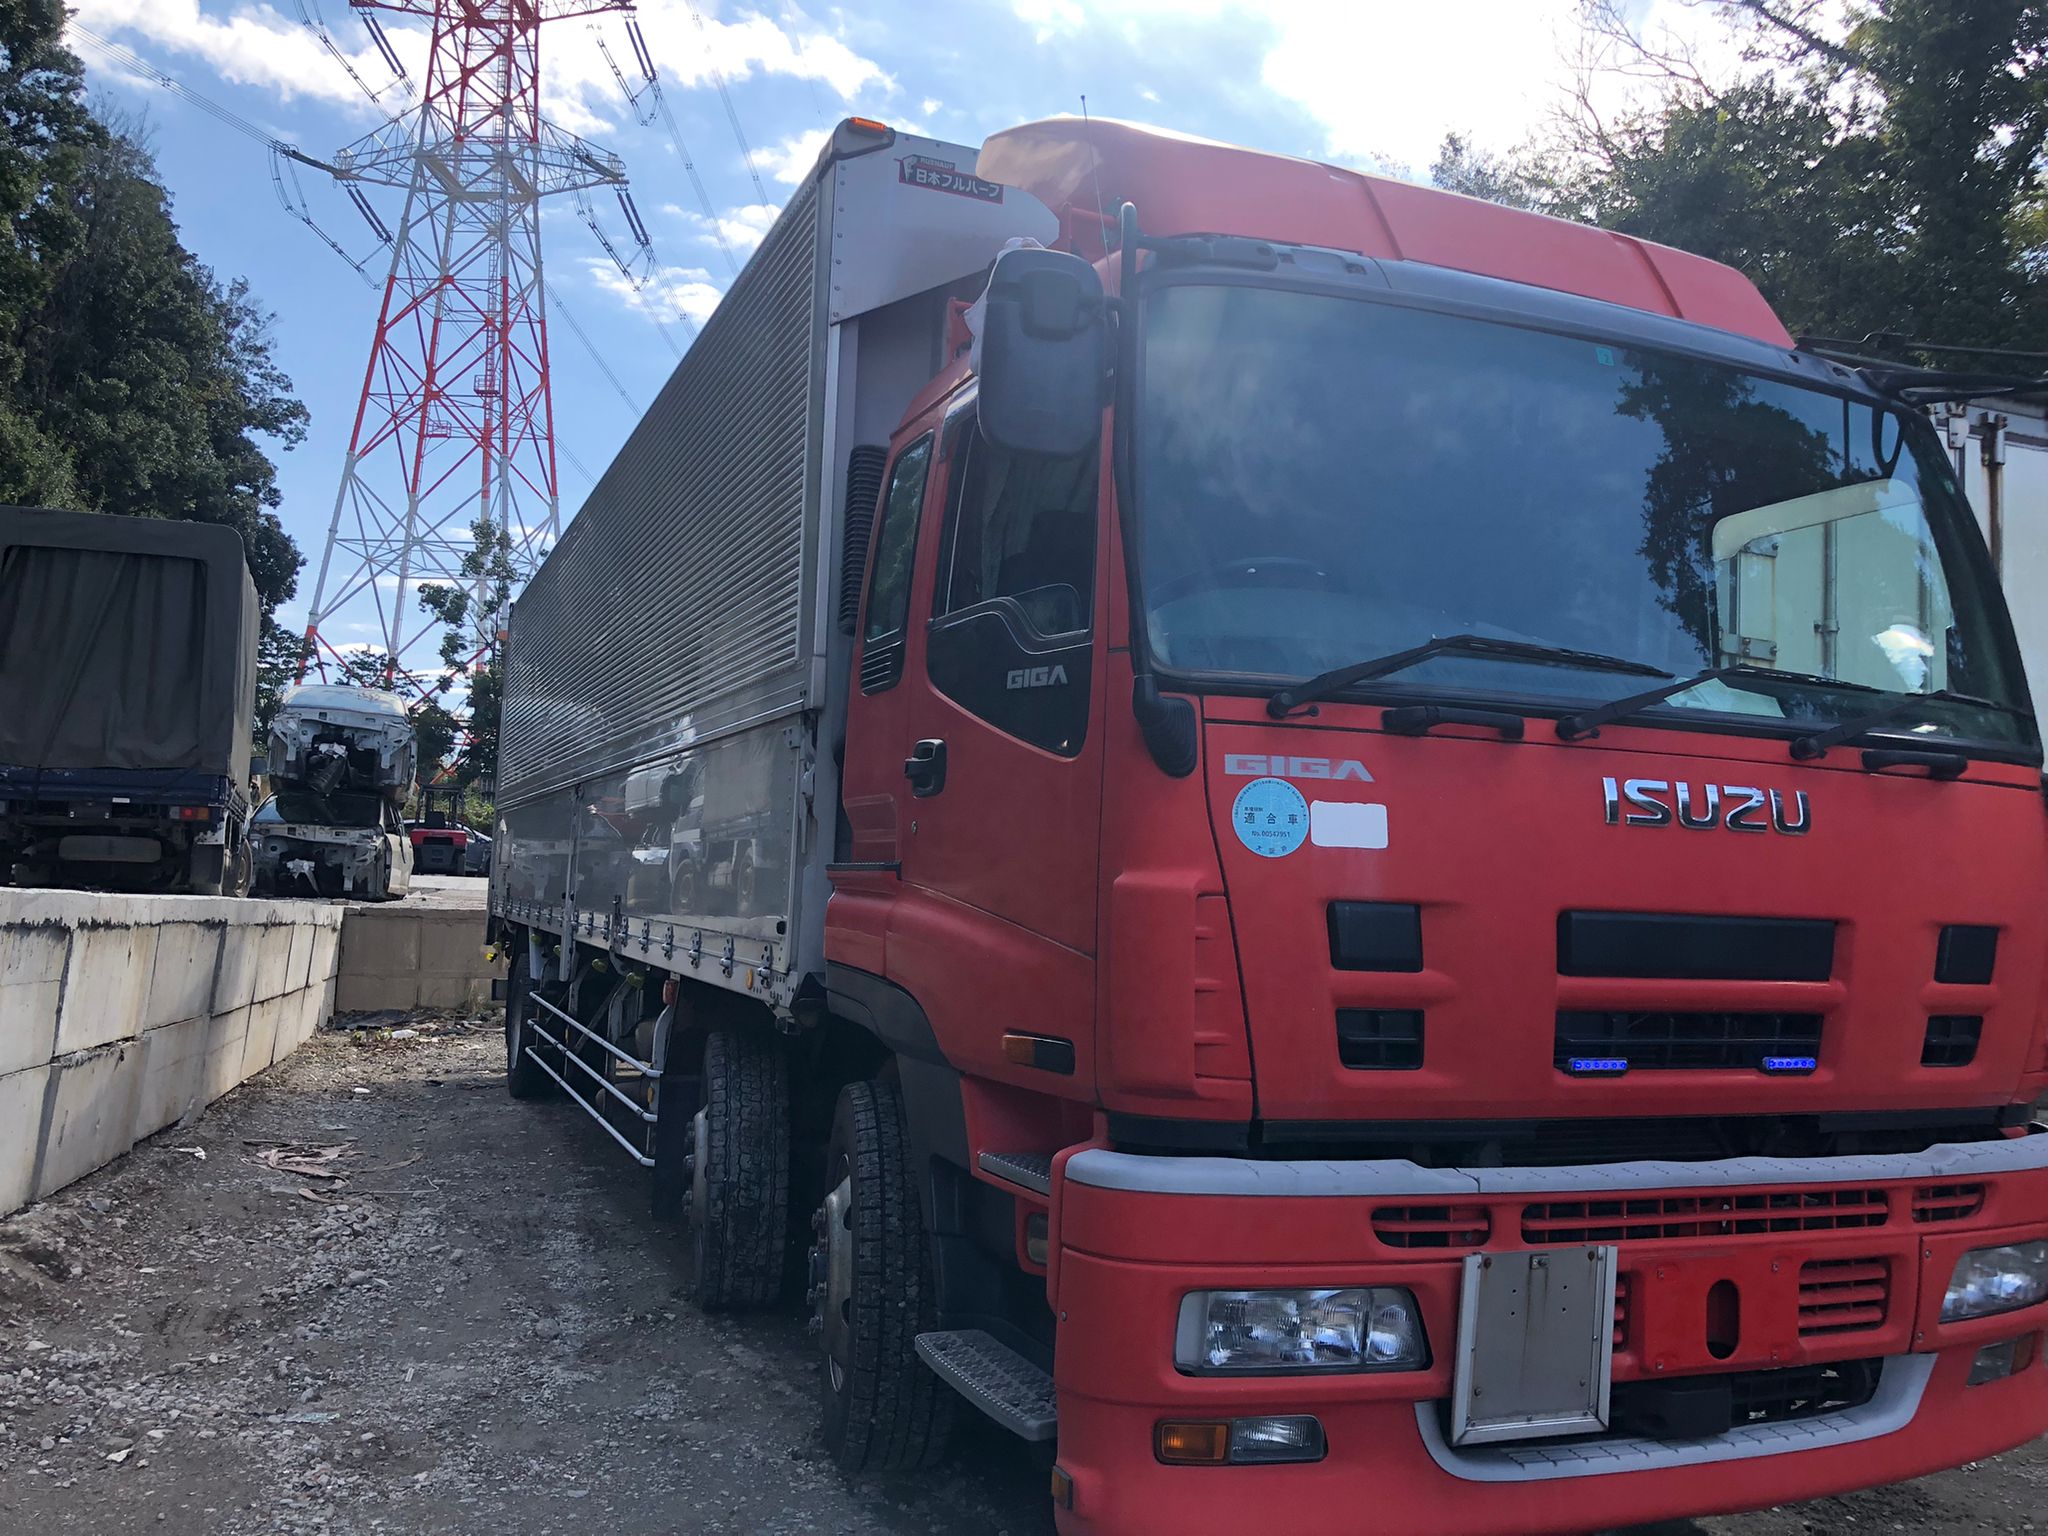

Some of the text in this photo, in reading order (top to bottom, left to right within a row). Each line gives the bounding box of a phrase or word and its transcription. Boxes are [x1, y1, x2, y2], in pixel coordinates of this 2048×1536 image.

[916, 168, 1000, 198] 日本フルハーフ
[1006, 664, 1068, 690] GIGA
[1224, 753, 1376, 783] GIGA
[1602, 776, 1812, 836] ISUZU
